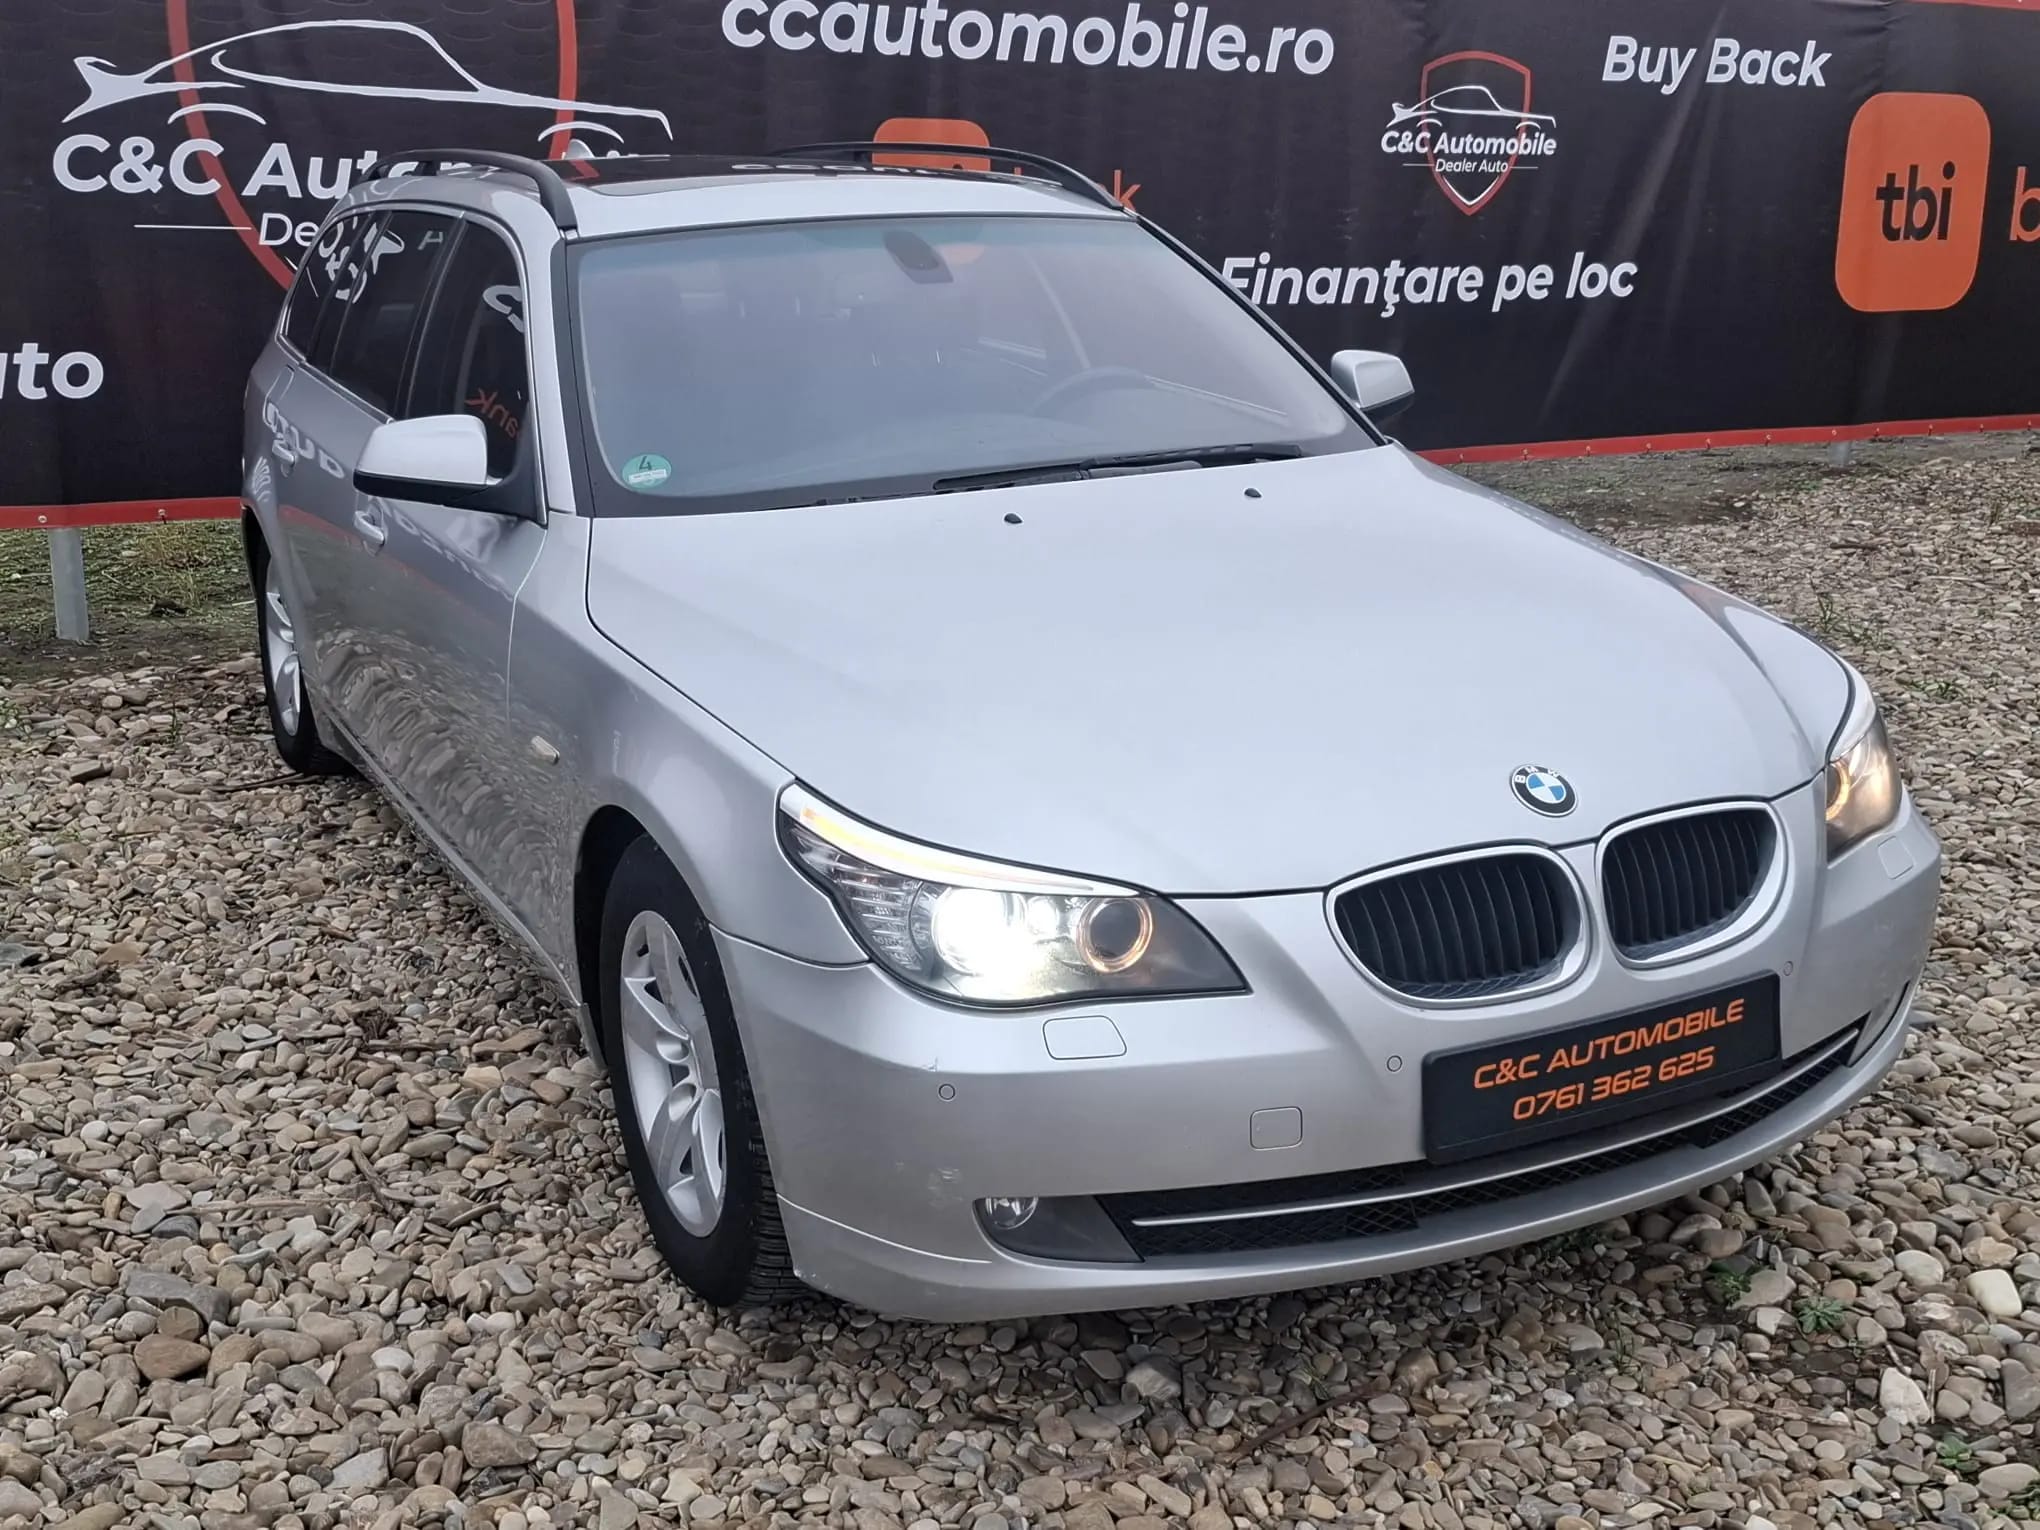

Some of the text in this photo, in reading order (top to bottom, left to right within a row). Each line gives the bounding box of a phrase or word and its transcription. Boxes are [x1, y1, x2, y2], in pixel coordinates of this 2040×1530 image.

[721, 0, 1335, 75] ccautomobile.ro
[1602, 35, 1833, 95] Buy Back
[53, 133, 225, 196] C&C
[1381, 130, 1558, 156] C&C Automobile
[1435, 158, 1509, 173] Dealer Auto
[1875, 161, 1956, 242] tbi
[1492, 262, 1554, 313] pe
[1565, 251, 1638, 299] loc
[1474, 998, 1745, 1089] C&C AUTOMOBILE
[1512, 1046, 1716, 1120] 0761 362 625
